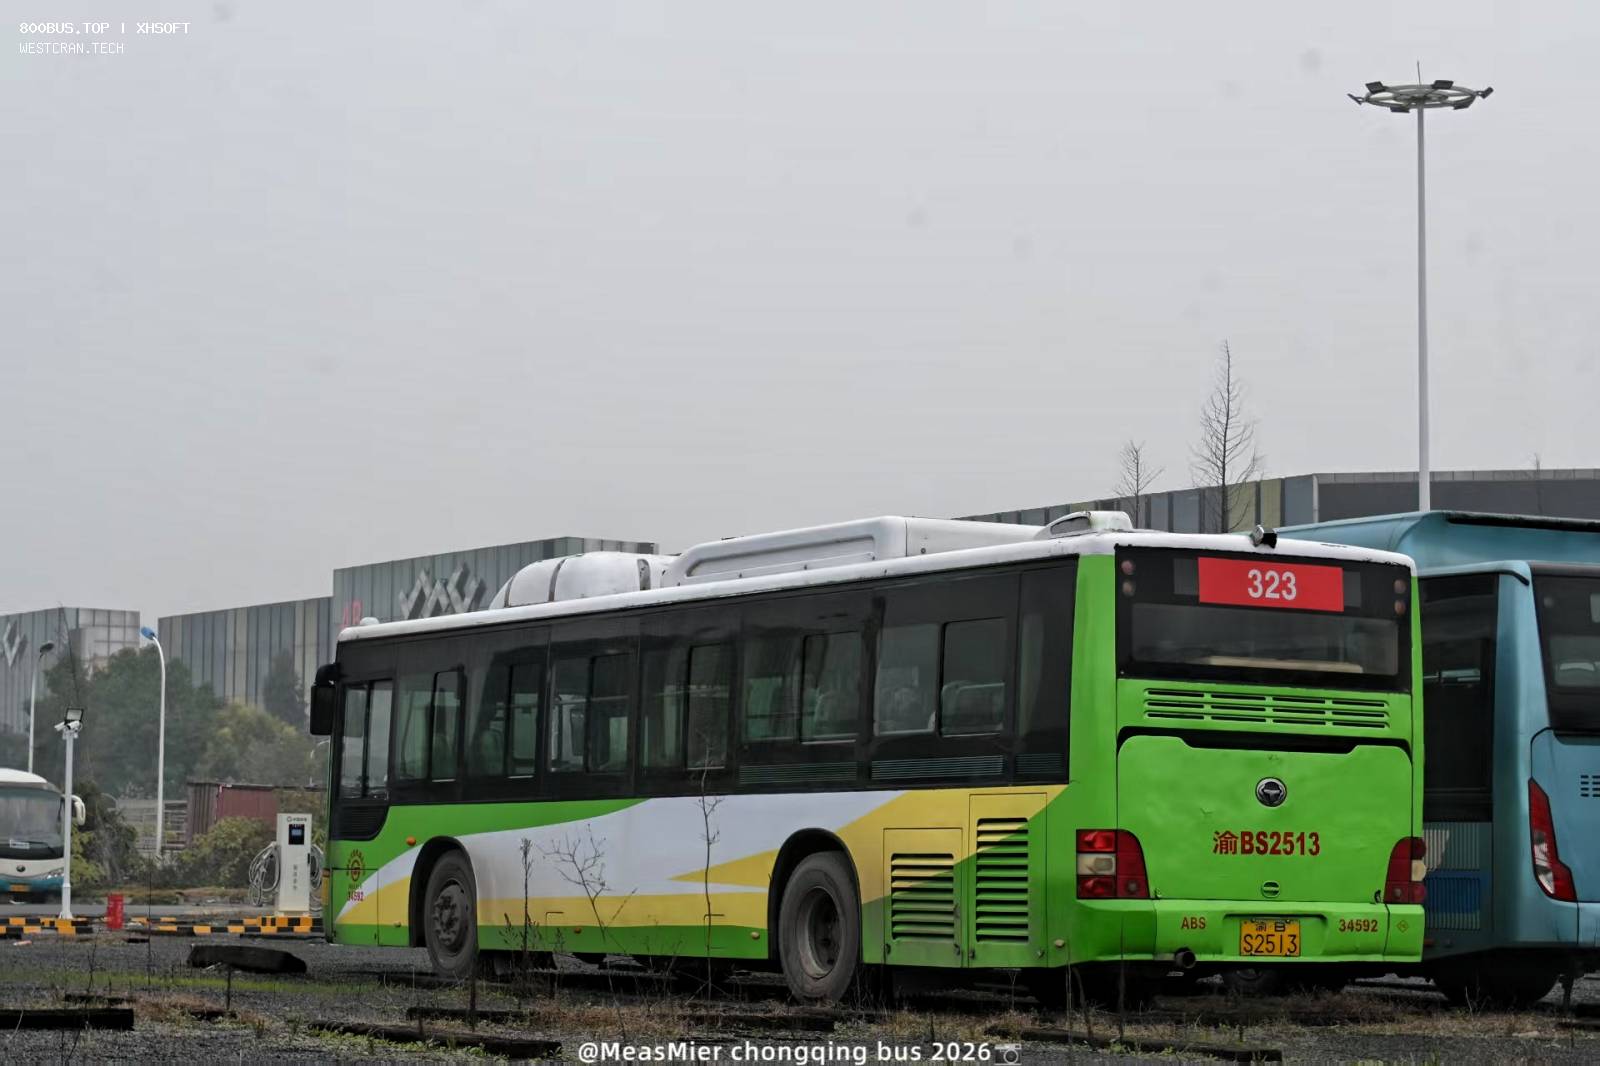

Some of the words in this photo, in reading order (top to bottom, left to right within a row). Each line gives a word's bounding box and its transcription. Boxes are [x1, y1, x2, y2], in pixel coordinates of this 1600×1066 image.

[1247, 569, 1297, 601] 323
[1213, 830, 1321, 856] 渝BS2513
[1181, 916, 1206, 930] ABS
[1338, 918, 1378, 932] 34592
[1243, 933, 1298, 954] S2513
